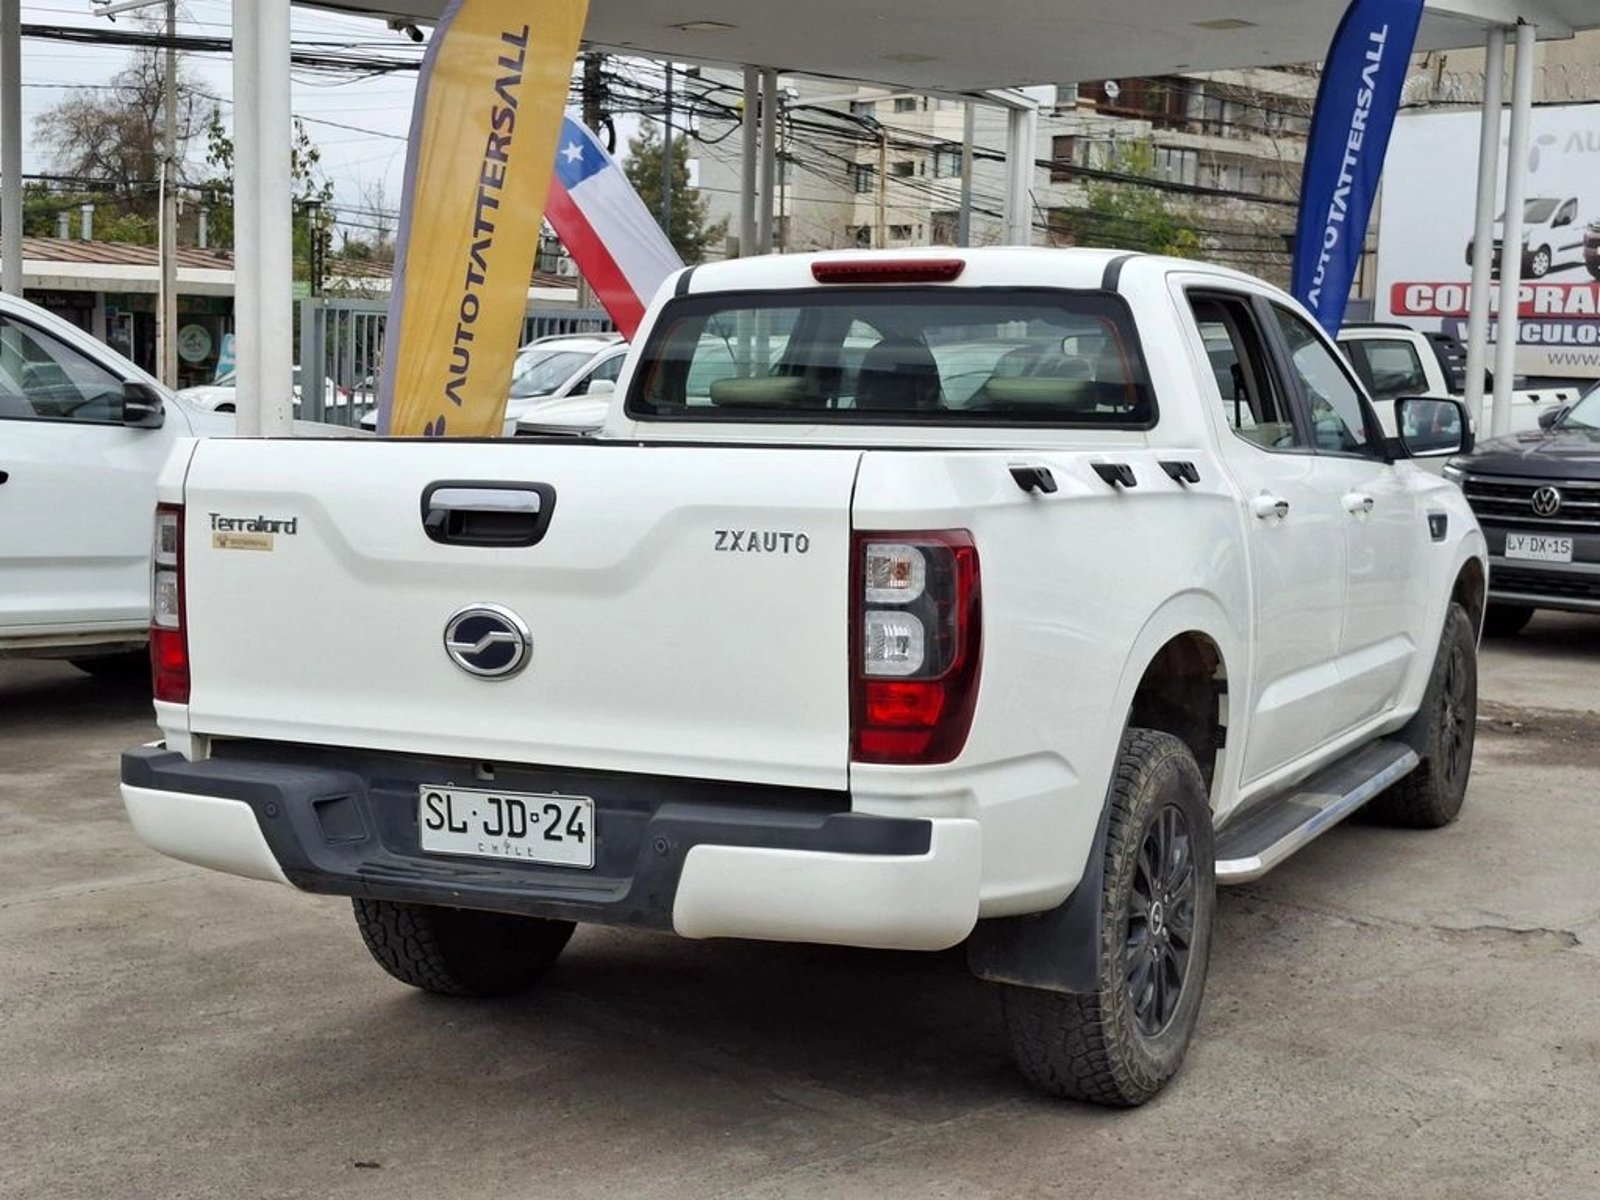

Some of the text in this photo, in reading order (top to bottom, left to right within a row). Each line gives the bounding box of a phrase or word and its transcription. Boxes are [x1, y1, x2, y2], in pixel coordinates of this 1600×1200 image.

[444, 24, 530, 407] AUTOTATTERSALL
[1307, 24, 1388, 309] AUTOTATTERSALL
[714, 529, 810, 554] ZXAUTO
